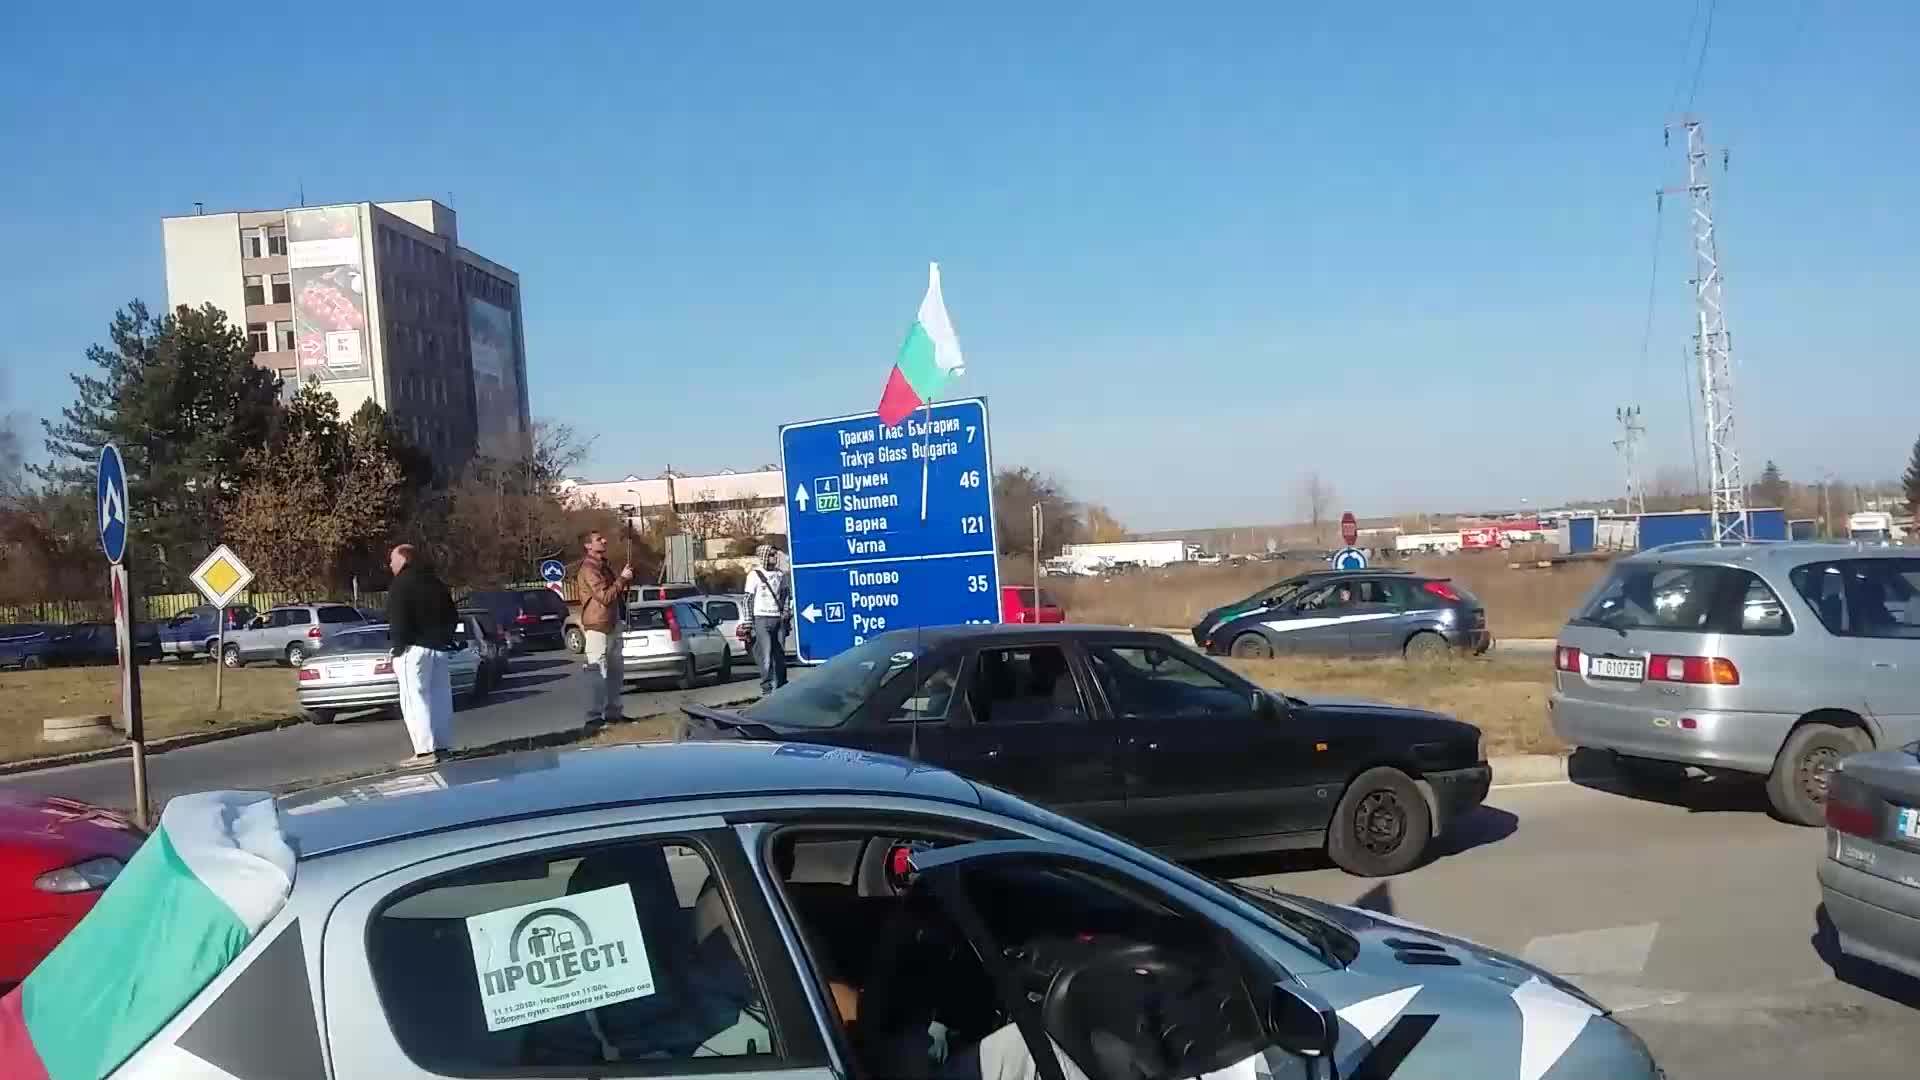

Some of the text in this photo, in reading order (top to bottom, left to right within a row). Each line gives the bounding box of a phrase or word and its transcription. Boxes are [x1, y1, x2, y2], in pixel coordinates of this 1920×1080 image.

[838, 428, 875, 446] Тракия
[878, 424, 904, 441] Глас
[966, 426, 976, 444] 7
[840, 450, 875, 468] Trakya
[878, 445, 908, 463] Glass
[824, 480, 831, 492] 4
[842, 471, 888, 492] Шумен
[960, 471, 980, 488] 46
[844, 494, 898, 512] Shumen
[845, 516, 887, 534] Варна
[961, 516, 984, 534] 121
[847, 538, 886, 554] Varna
[849, 570, 899, 586] Попово
[968, 575, 988, 592] 35
[851, 592, 899, 610] Popovo
[829, 606, 841, 618] 74
[853, 614, 886, 633] Русе
[483, 940, 628, 996] ПРОТЕСТ!
